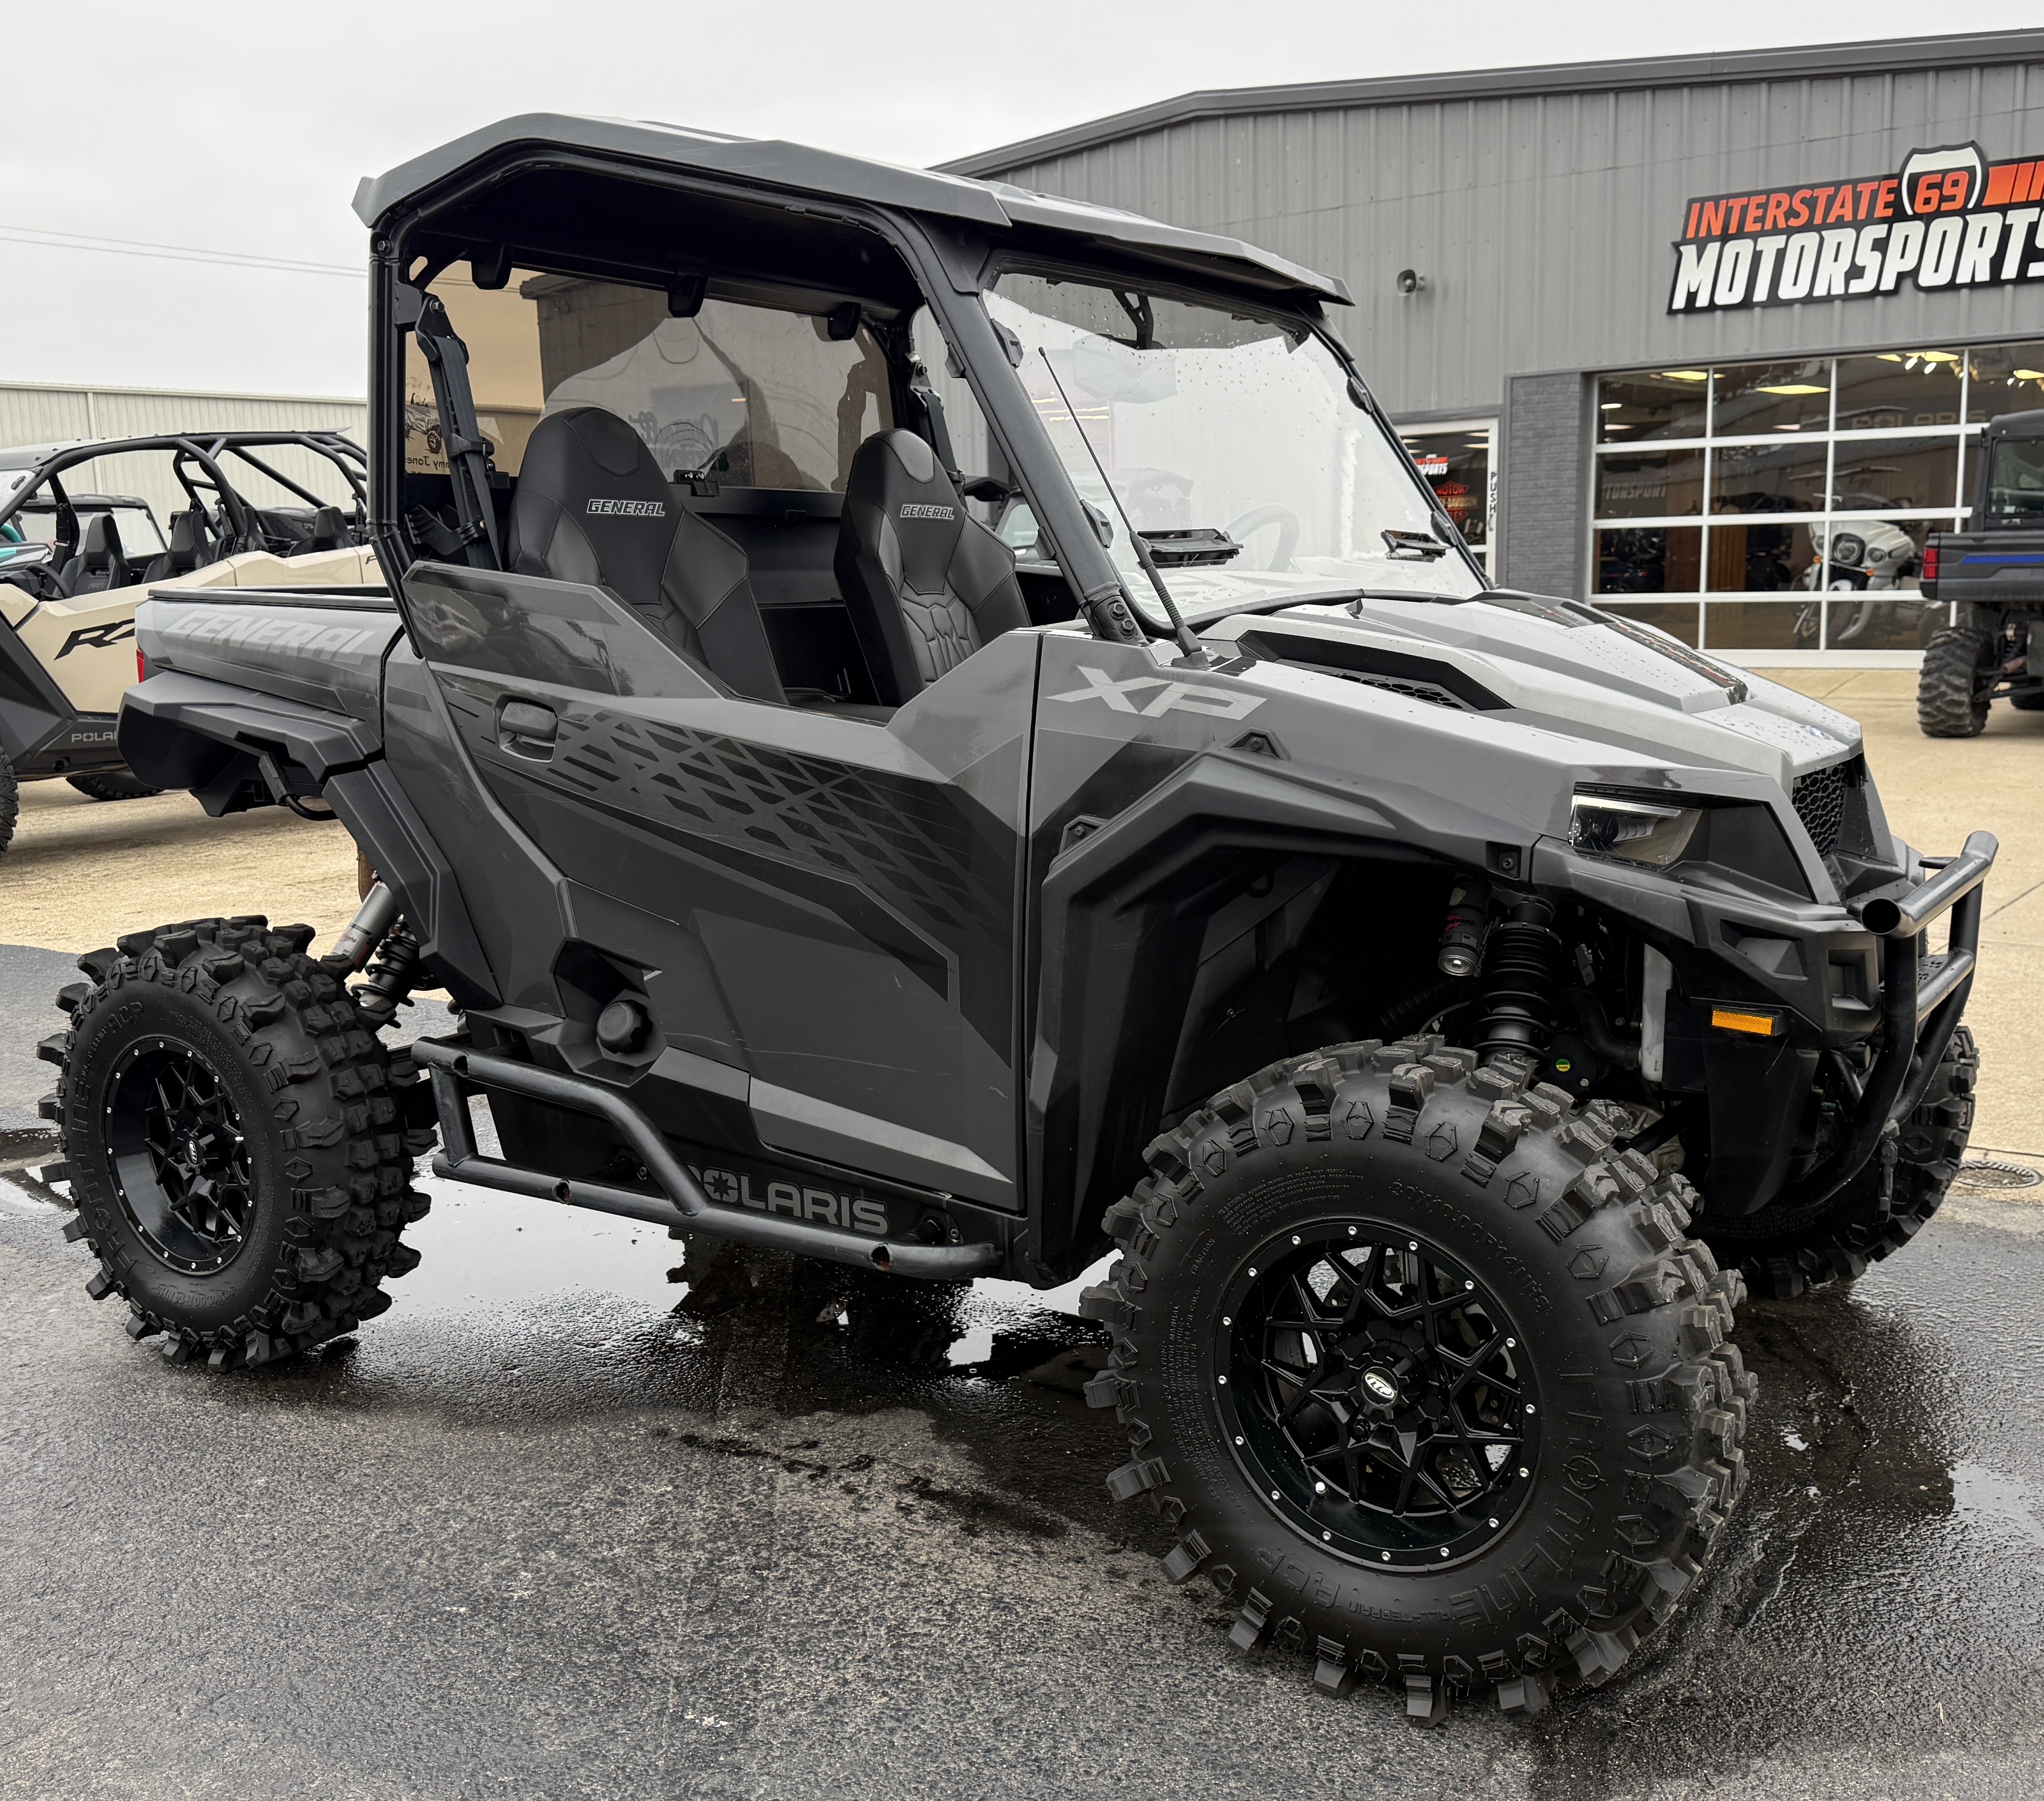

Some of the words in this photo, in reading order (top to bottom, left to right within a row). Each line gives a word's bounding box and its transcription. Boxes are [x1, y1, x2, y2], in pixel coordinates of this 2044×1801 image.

[1686, 179, 1898, 239] INTERSTATE
[1914, 170, 1970, 214] 69
[586, 499, 665, 516] GENERAL
[900, 504, 954, 520] GENERAL
[161, 610, 376, 665] GENERAL
[1044, 664, 1267, 721] XP
[71, 731, 117, 743] POLA
[688, 1162, 888, 1234] OLARIS
[1190, 1238, 1216, 1275] TRACTION
